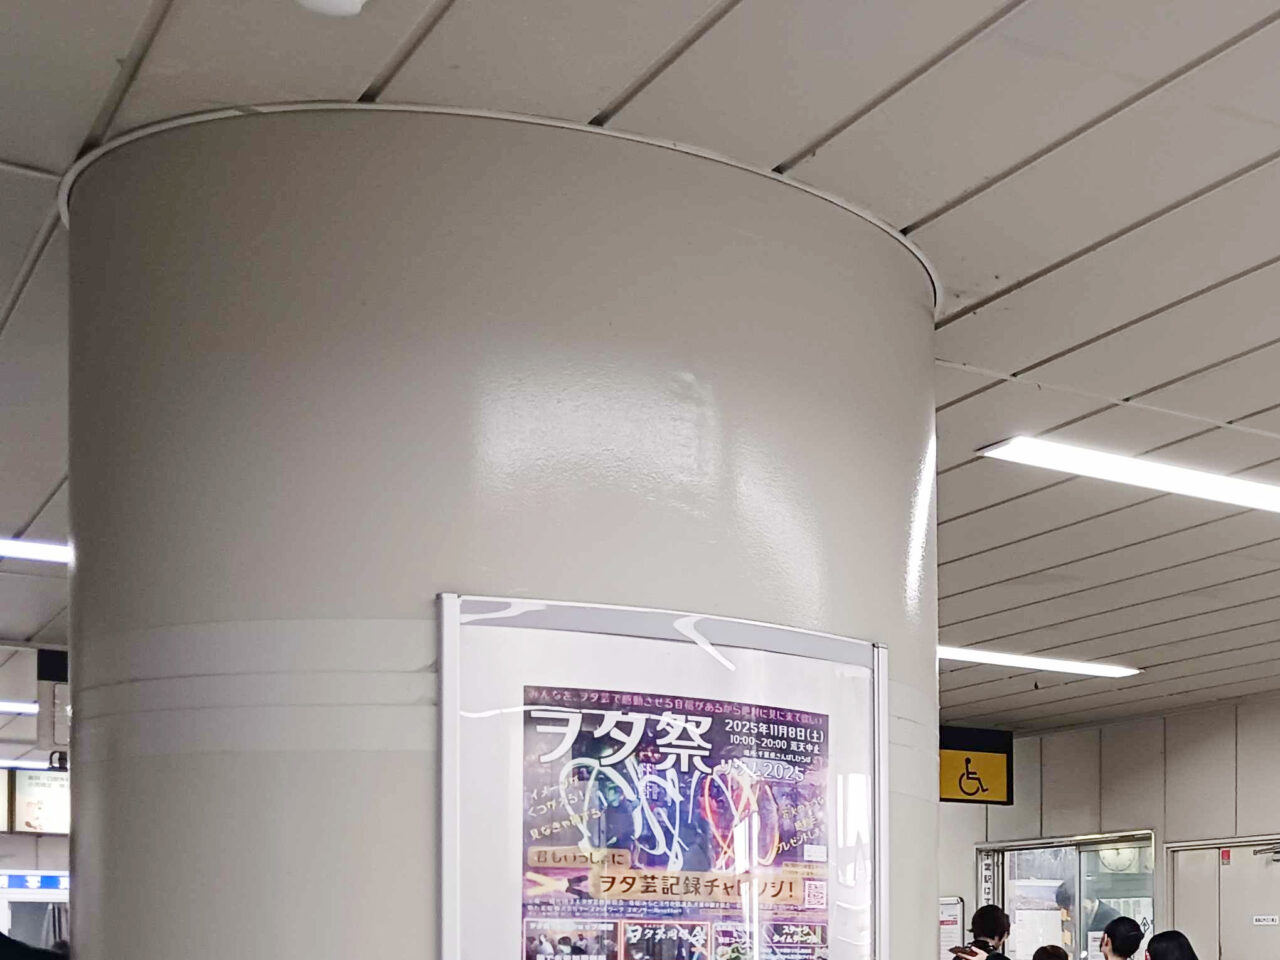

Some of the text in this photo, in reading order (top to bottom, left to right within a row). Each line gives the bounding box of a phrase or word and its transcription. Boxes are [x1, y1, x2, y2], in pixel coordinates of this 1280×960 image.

[530, 710, 712, 774] ヲタ祭
[725, 719, 824, 743] 2025年11月8日(土)
